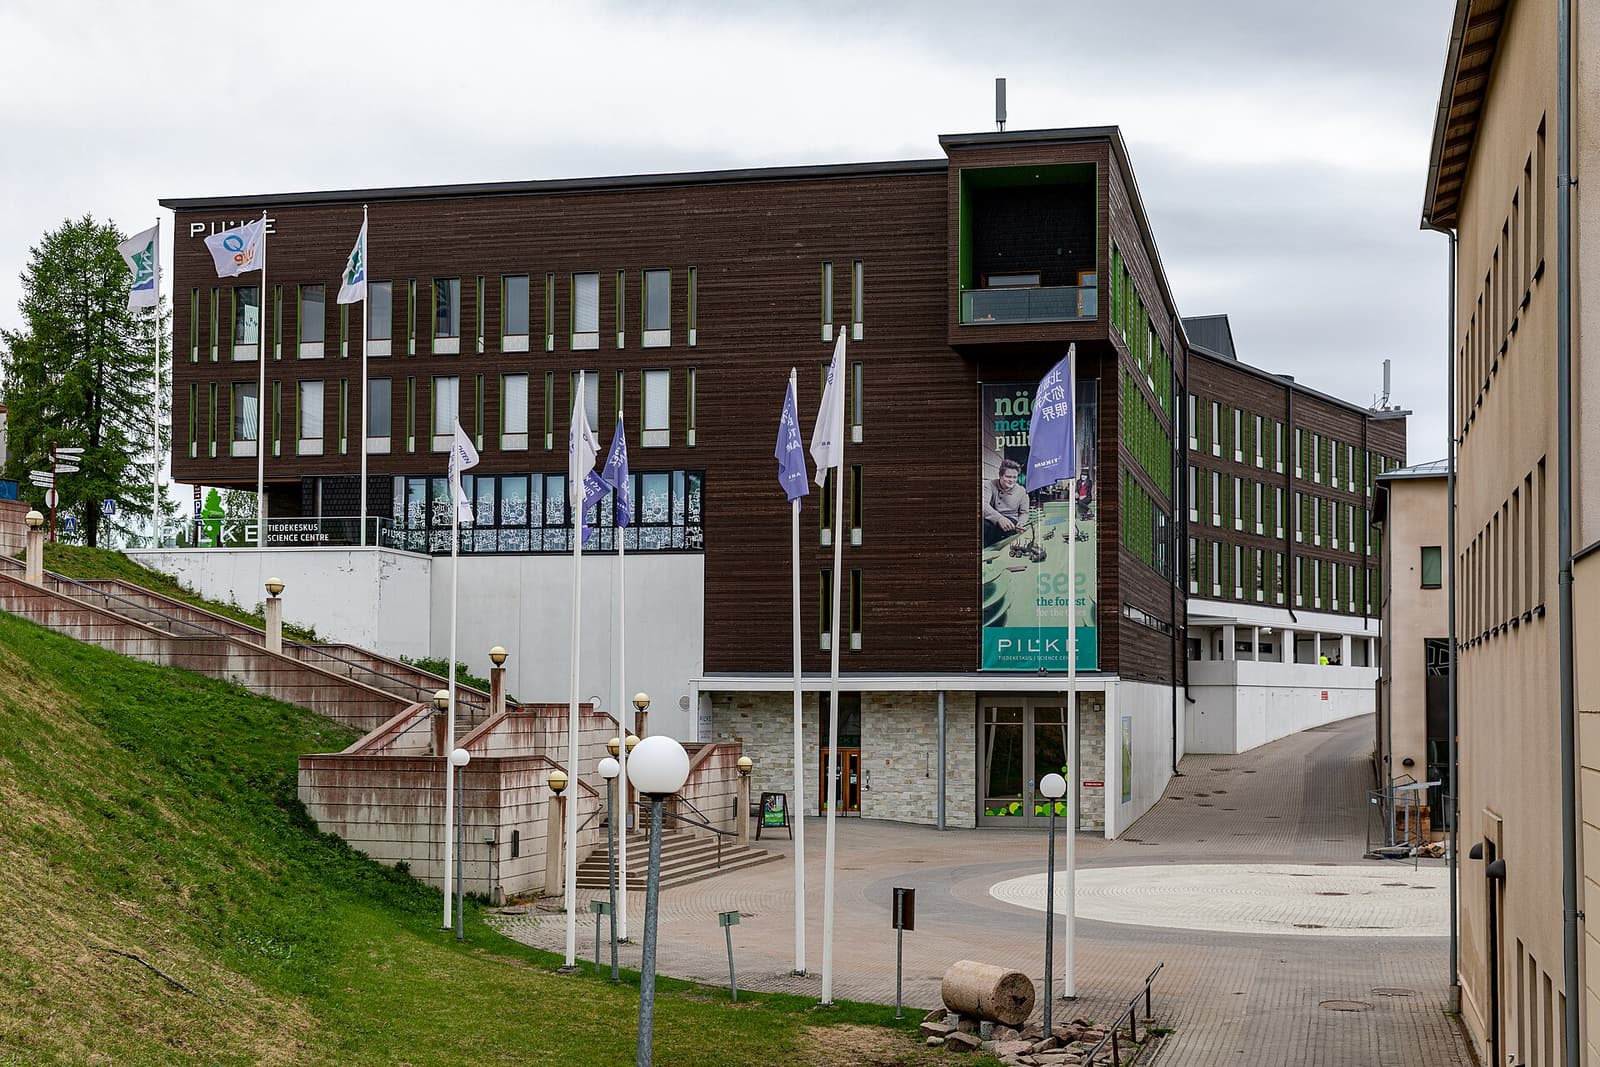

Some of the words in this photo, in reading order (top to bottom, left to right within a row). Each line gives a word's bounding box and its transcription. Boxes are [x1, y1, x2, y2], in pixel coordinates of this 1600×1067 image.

[994, 390, 1036, 416] nä
[268, 523, 319, 532] TIEDEKESKUS
[267, 533, 298, 542] SCIENCE
[300, 533, 329, 541] CENTRE
[1036, 572, 1087, 595] see
[1036, 596, 1054, 606] the
[1055, 596, 1086, 606] forst
